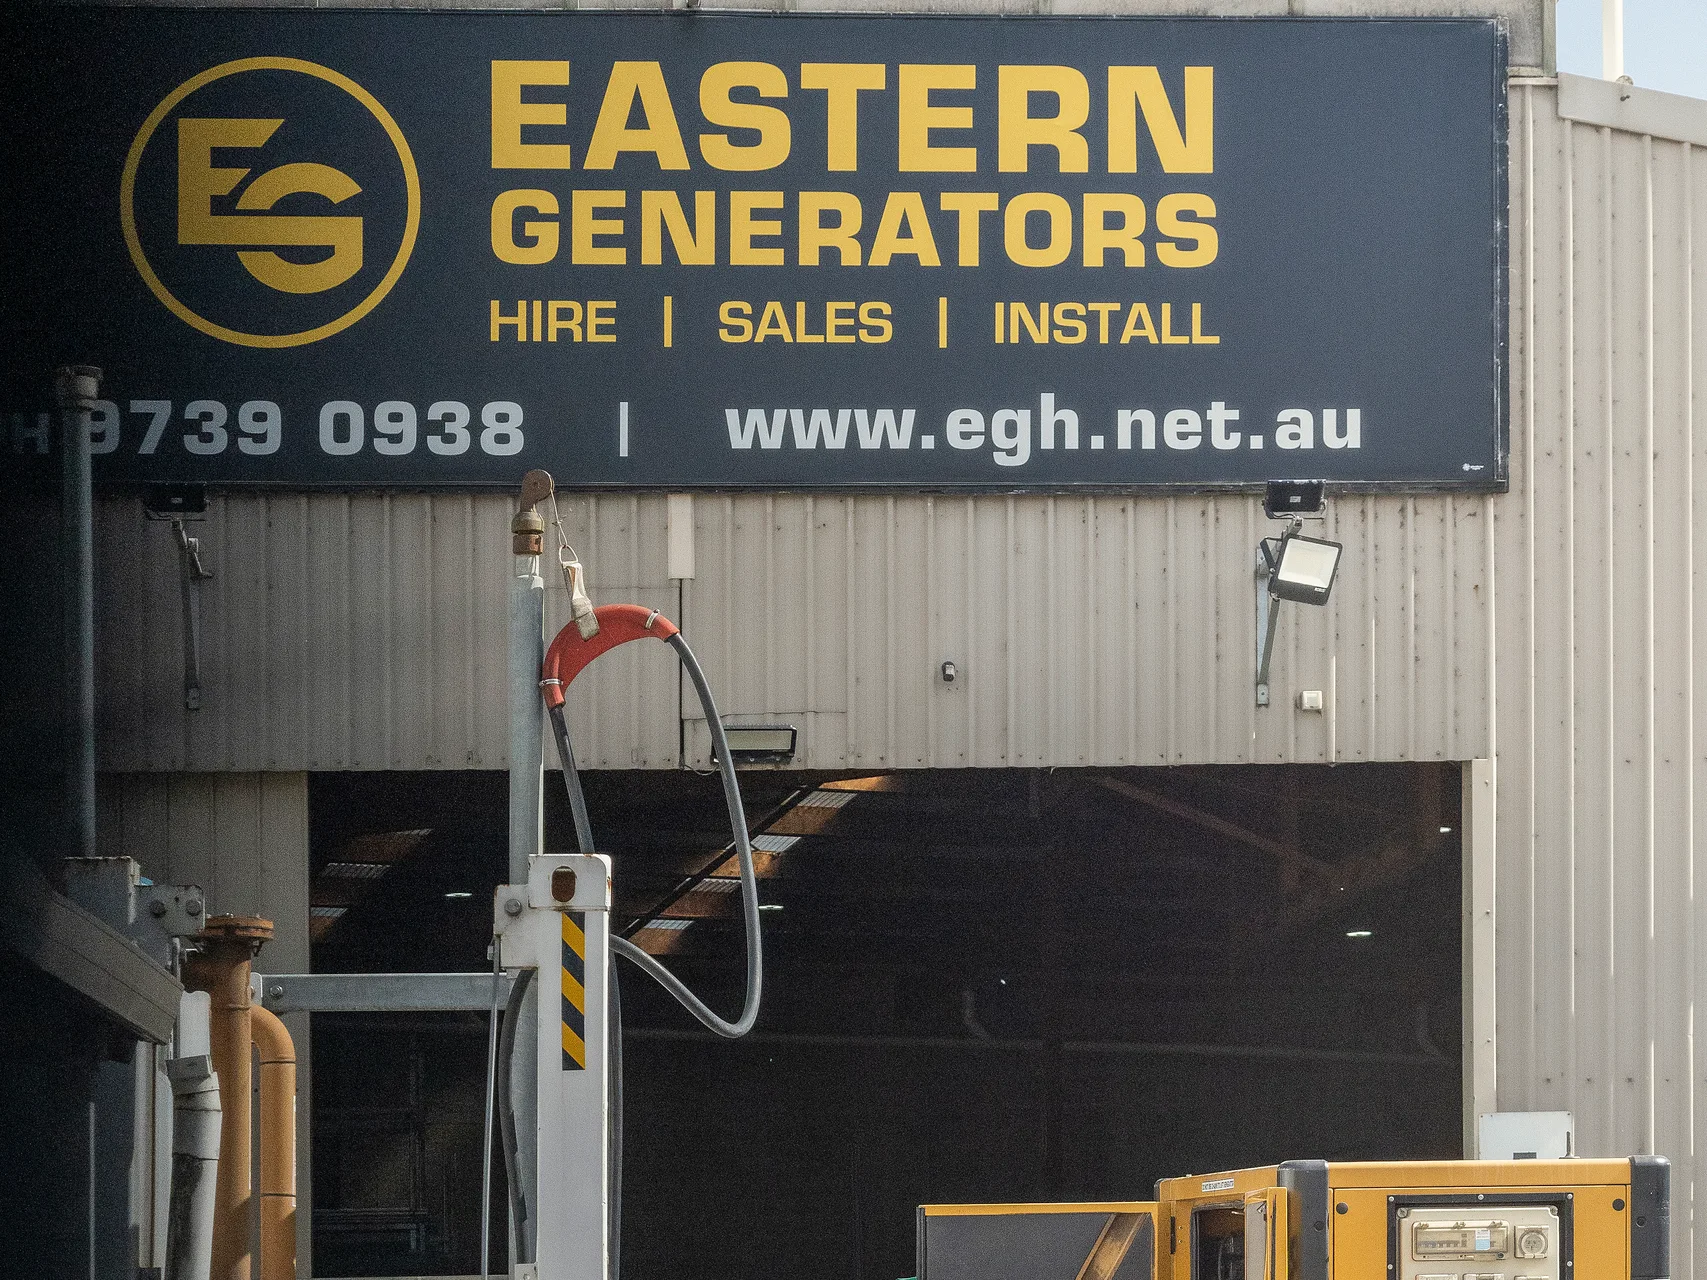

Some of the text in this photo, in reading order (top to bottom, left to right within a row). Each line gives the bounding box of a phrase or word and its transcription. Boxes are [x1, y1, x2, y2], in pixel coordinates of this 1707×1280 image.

[491, 60, 1214, 174] EASTERN
[490, 189, 1220, 269] GENERATORS
[489, 299, 617, 344] HIRE
[719, 300, 893, 345] SALES
[994, 302, 1220, 346] INSTALL
[88, 400, 282, 456] 9739
[318, 400, 525, 457] 0938
[724, 392, 1363, 467] www.egh.net.au
